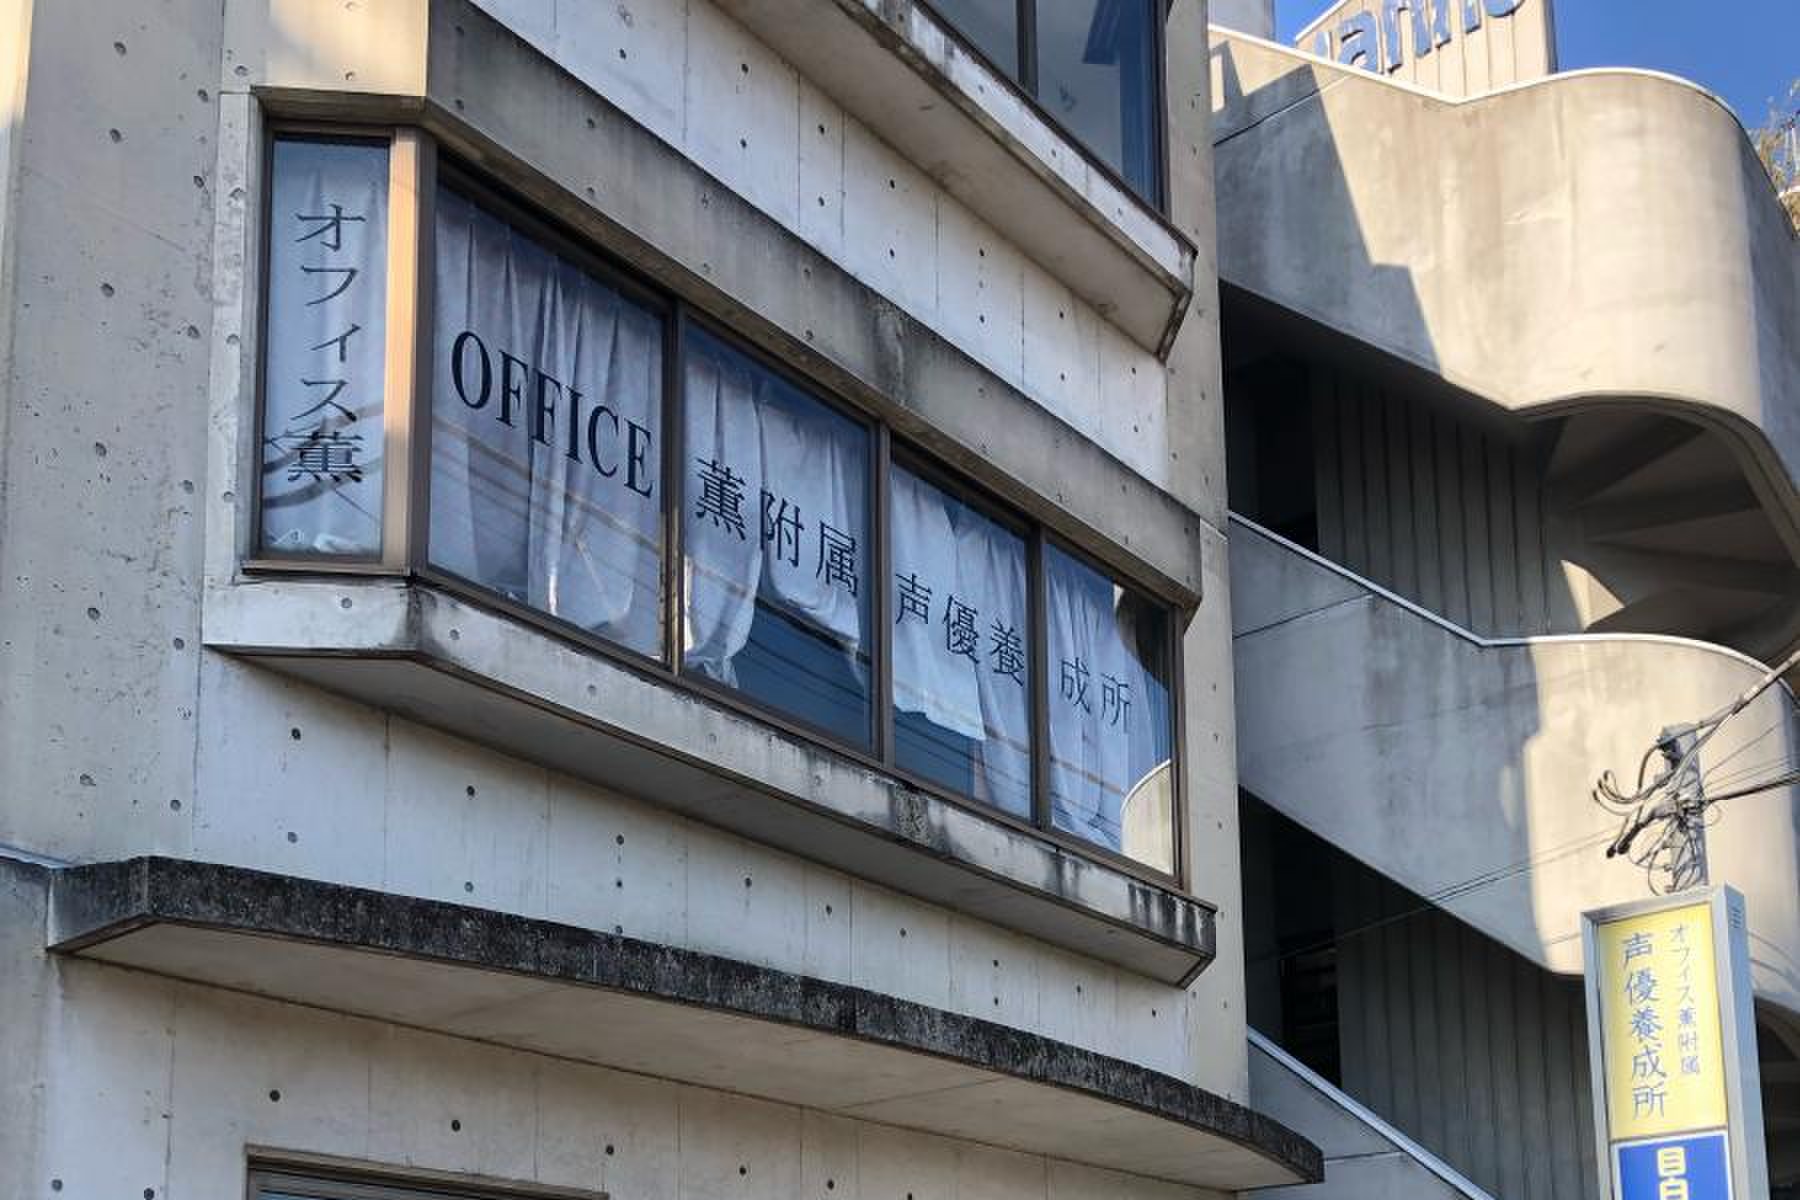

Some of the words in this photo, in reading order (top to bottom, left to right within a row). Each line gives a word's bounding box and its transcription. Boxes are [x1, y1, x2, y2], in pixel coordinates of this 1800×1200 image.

[451, 330, 654, 499] OFFICE
[1620, 931, 1668, 1121] 声優養成所
